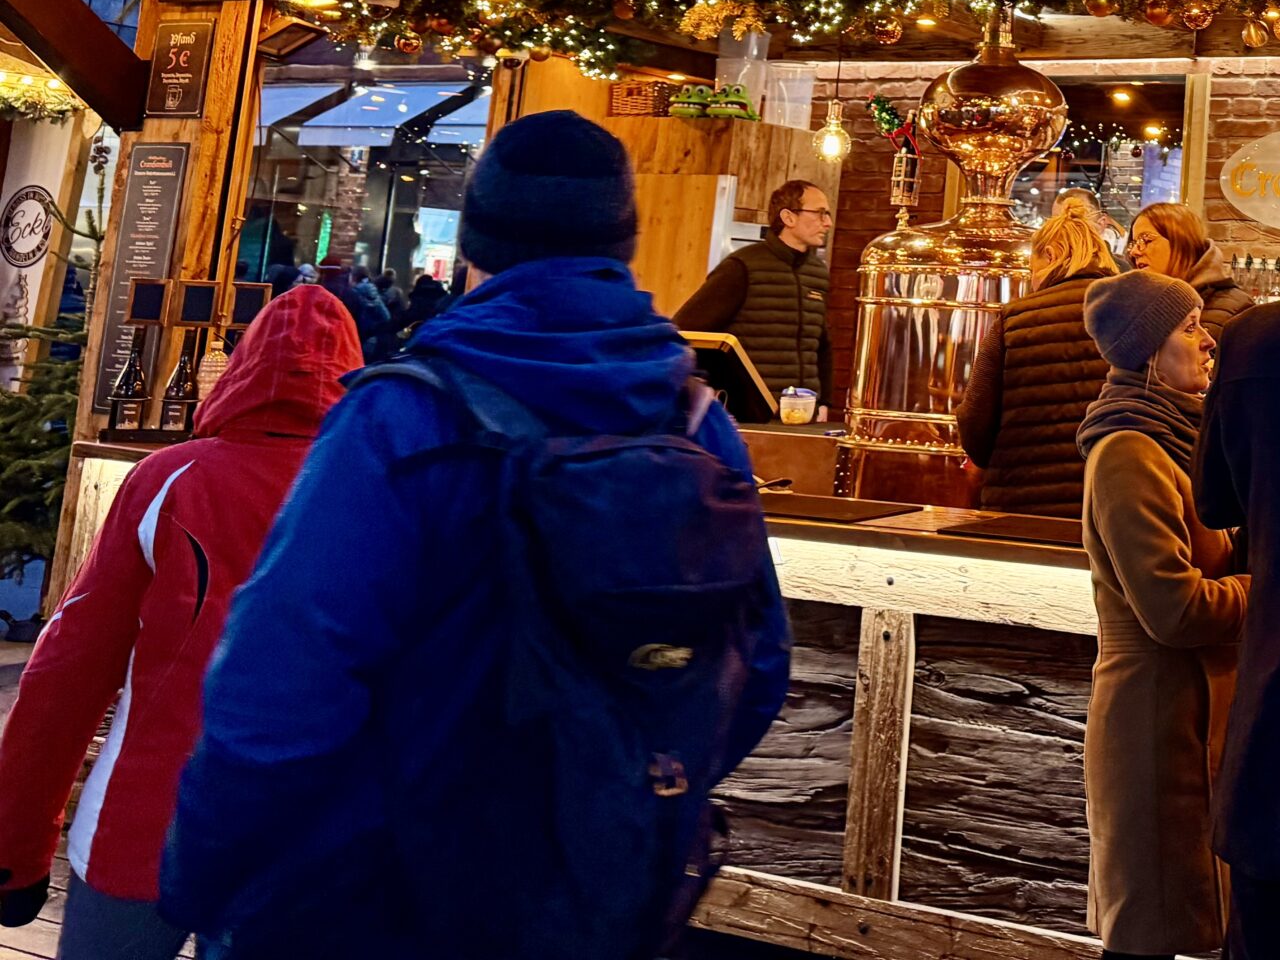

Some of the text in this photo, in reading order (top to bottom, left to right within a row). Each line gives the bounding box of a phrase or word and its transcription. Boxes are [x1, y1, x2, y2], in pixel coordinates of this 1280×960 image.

[170, 32, 196, 46] Pfand
[167, 48, 190, 69] 5 €
